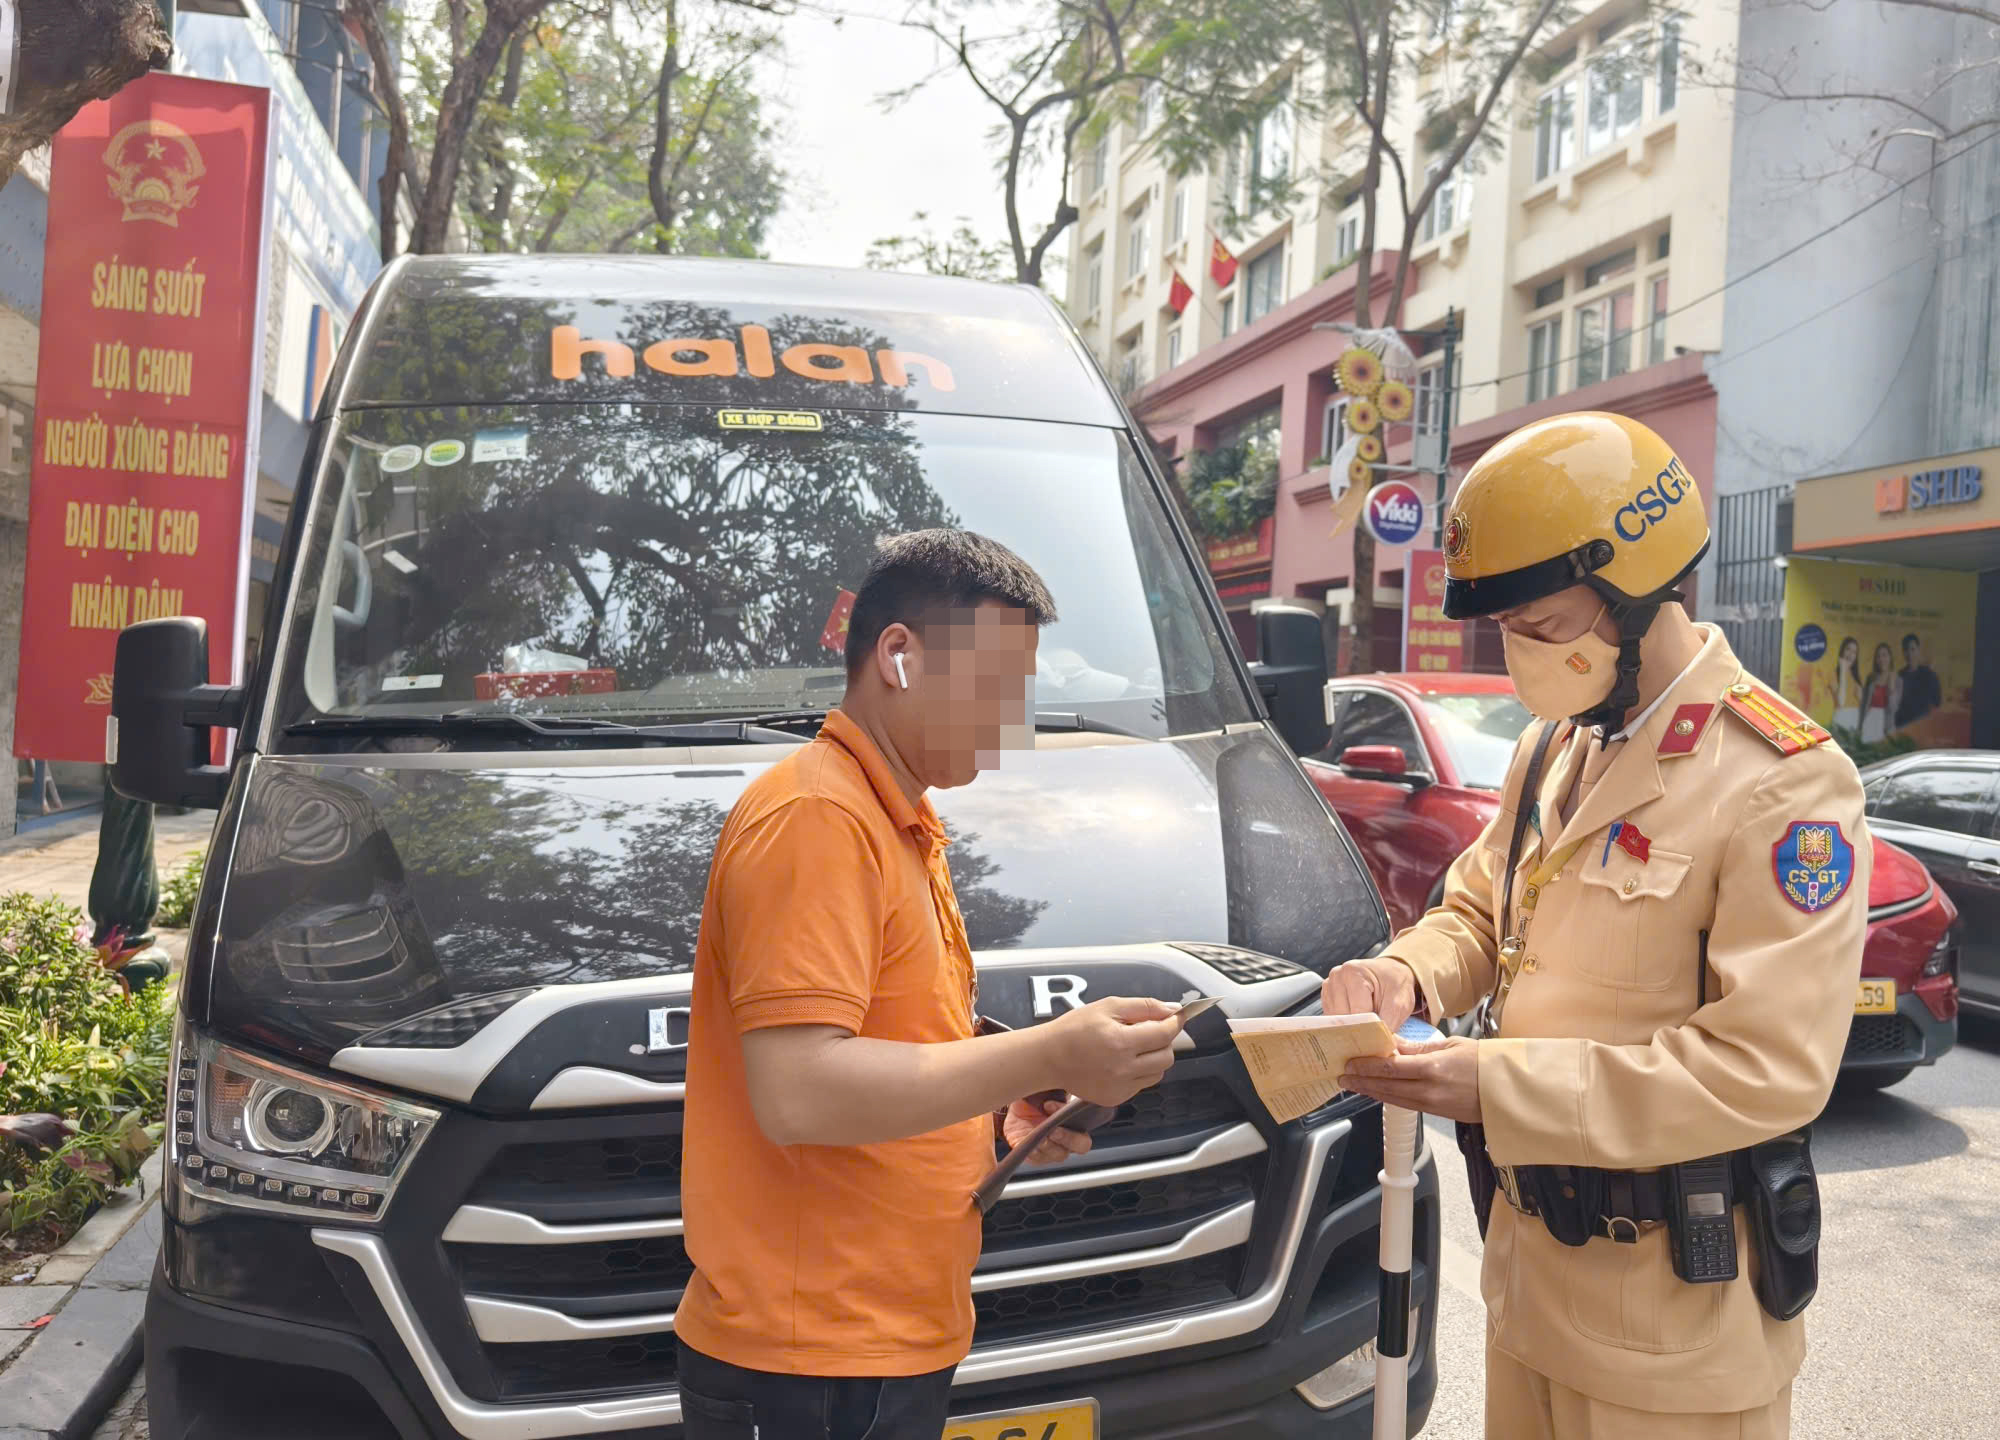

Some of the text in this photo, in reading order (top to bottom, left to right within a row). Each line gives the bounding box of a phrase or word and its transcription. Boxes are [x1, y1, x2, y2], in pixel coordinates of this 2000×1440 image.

[92, 255, 205, 318] SÁNG SUỐT
[92, 341, 192, 405] LỰA CHỌN
[552, 325, 956, 392] halan
[44, 412, 229, 478] NGƯỜI XỨNG ĐÁNG
[724, 414, 744, 425] XE
[1614, 455, 1691, 542] CSGT
[1910, 465, 1983, 511] SHB
[65, 497, 199, 561] ĐẠI DIỆN CHO
[70, 575, 129, 629] NHÂN
[1788, 869, 1840, 884] CS GT
[1029, 974, 1088, 1018] R
